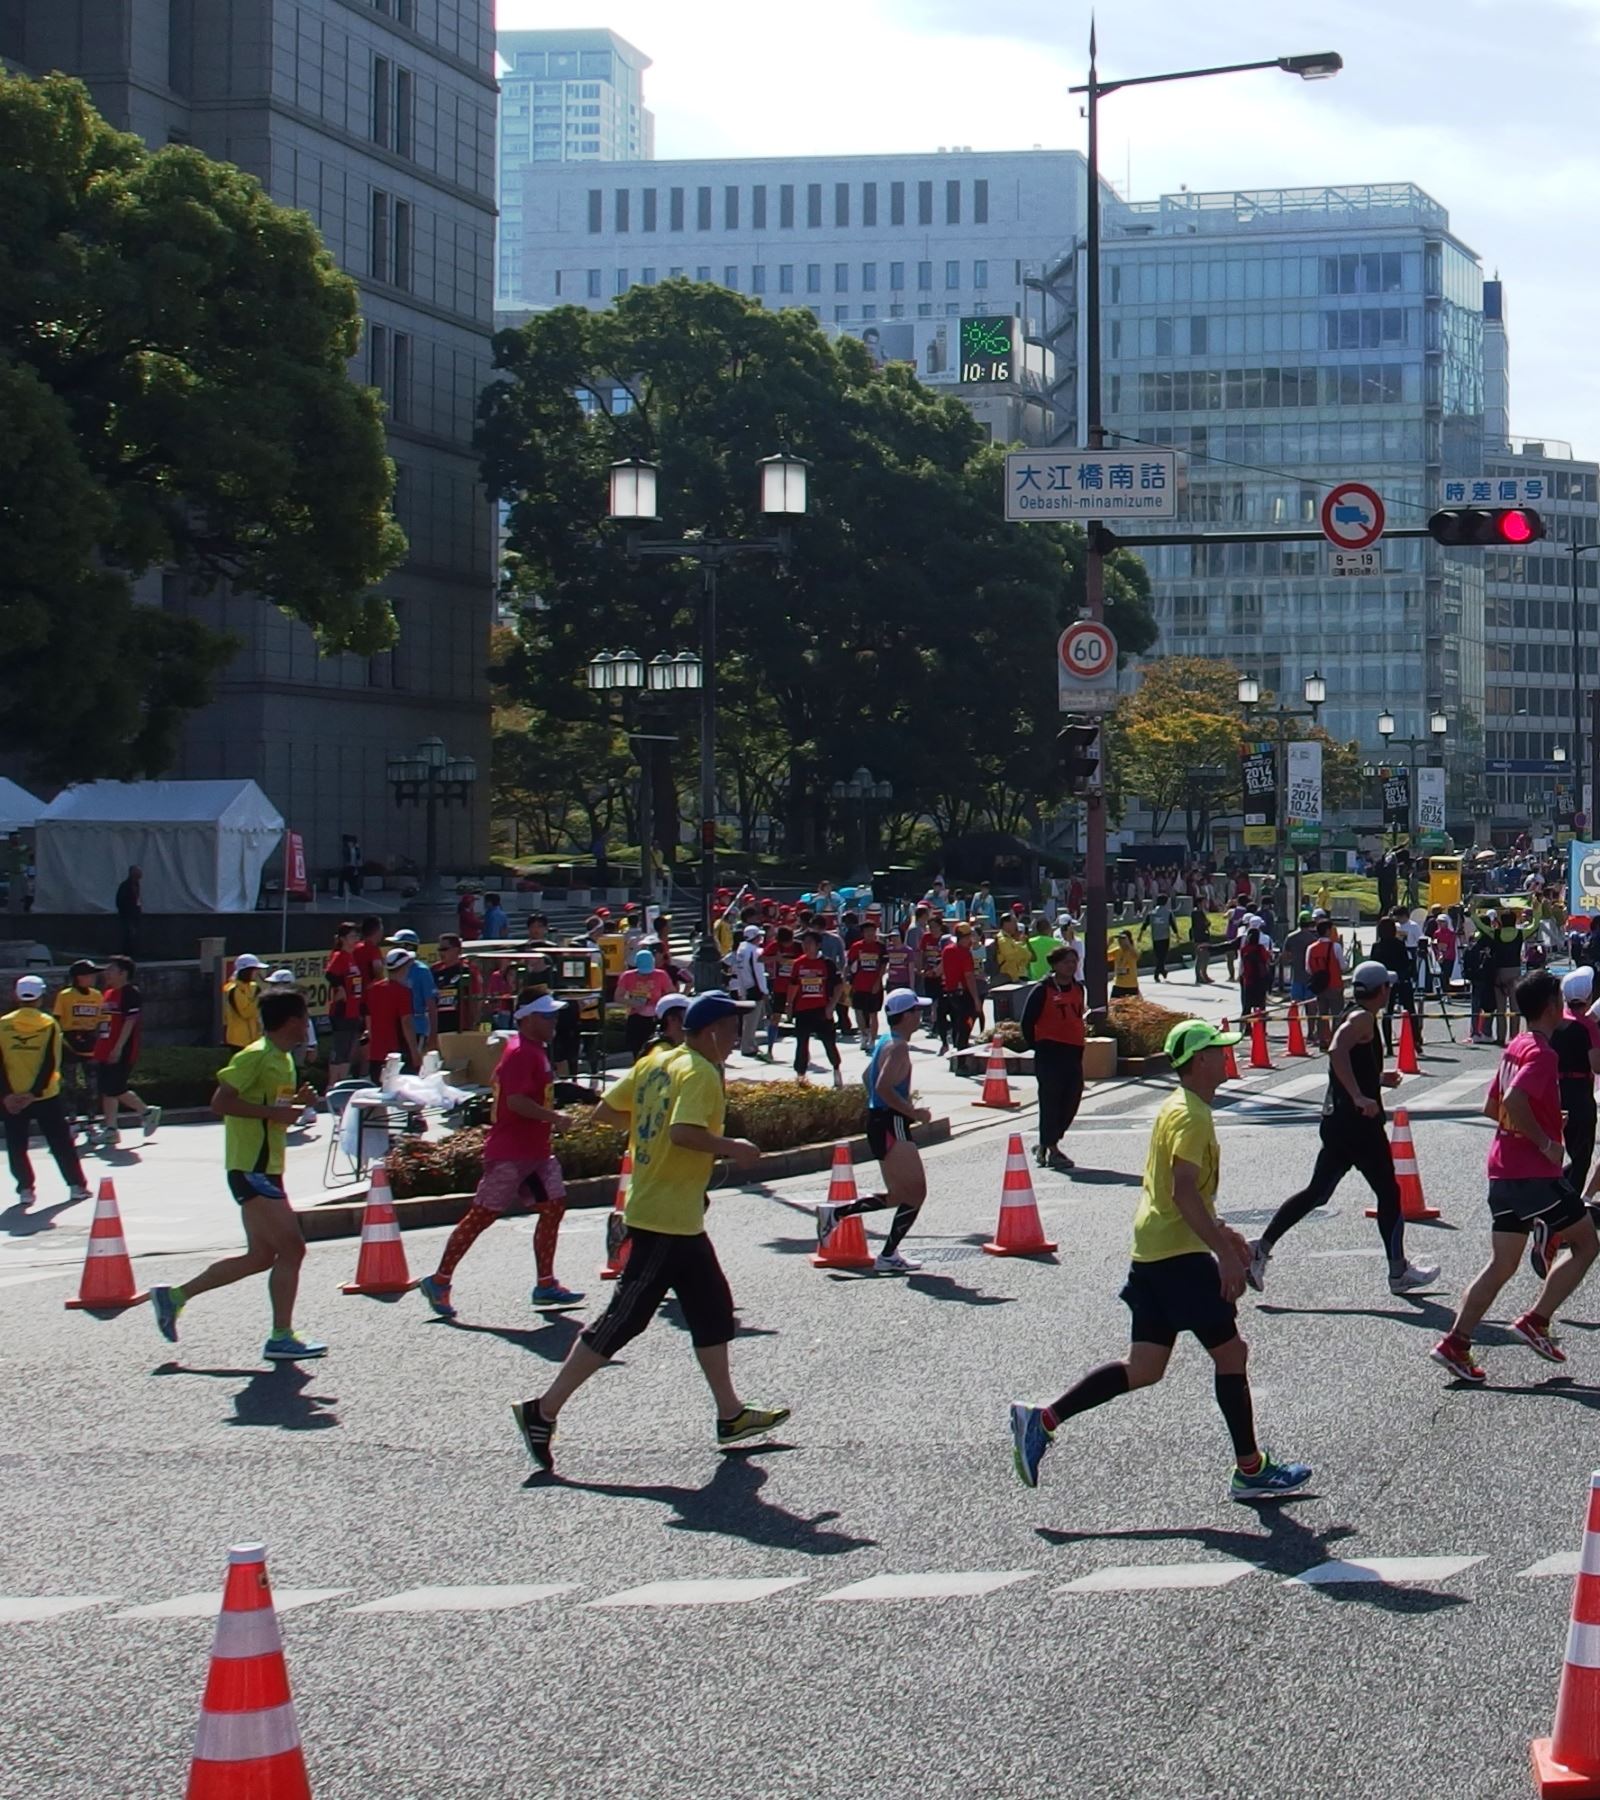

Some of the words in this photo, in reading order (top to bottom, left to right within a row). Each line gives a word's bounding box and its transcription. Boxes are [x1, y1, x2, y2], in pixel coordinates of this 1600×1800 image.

[1016, 463, 1165, 491] 大江橋南詰
[1446, 481, 1544, 501] 時差信号
[1020, 494, 1162, 509] Oebashi-minamizume
[1074, 639, 1102, 661] 60
[1245, 765, 1272, 779] 2014
[1247, 777, 1274, 789] 10.26
[1291, 789, 1318, 802] 2014
[1290, 801, 1319, 814] 10.26
